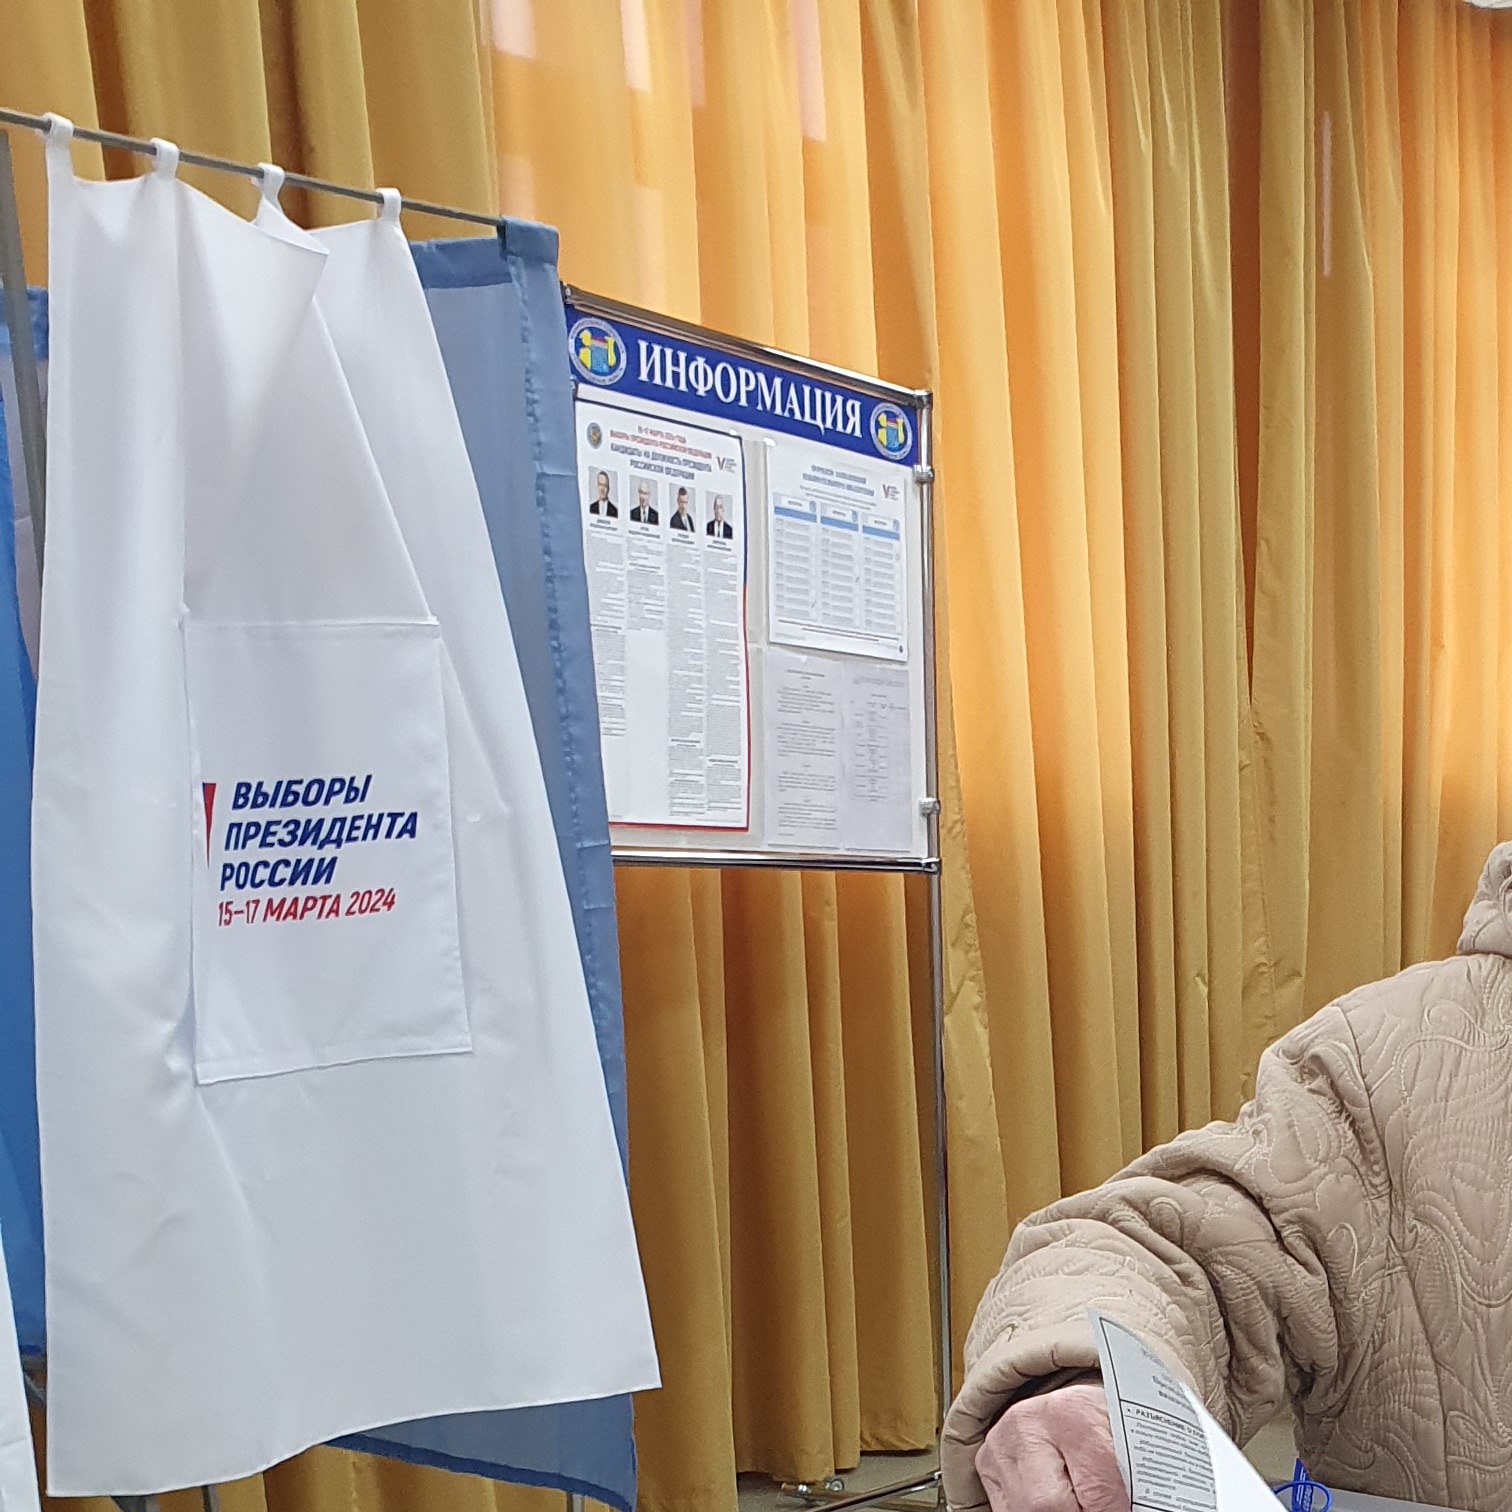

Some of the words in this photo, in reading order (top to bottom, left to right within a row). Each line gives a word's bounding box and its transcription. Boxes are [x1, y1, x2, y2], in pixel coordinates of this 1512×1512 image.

[637, 338, 862, 438] ИНФОРМАЦИЯ
[231, 774, 373, 811] ВЫБОРЫ
[224, 811, 418, 851] ПРЕЗИДЕНТА
[219, 856, 338, 891] РОССИИ
[263, 893, 342, 922] МАРТА
[345, 887, 396, 917] 2024
